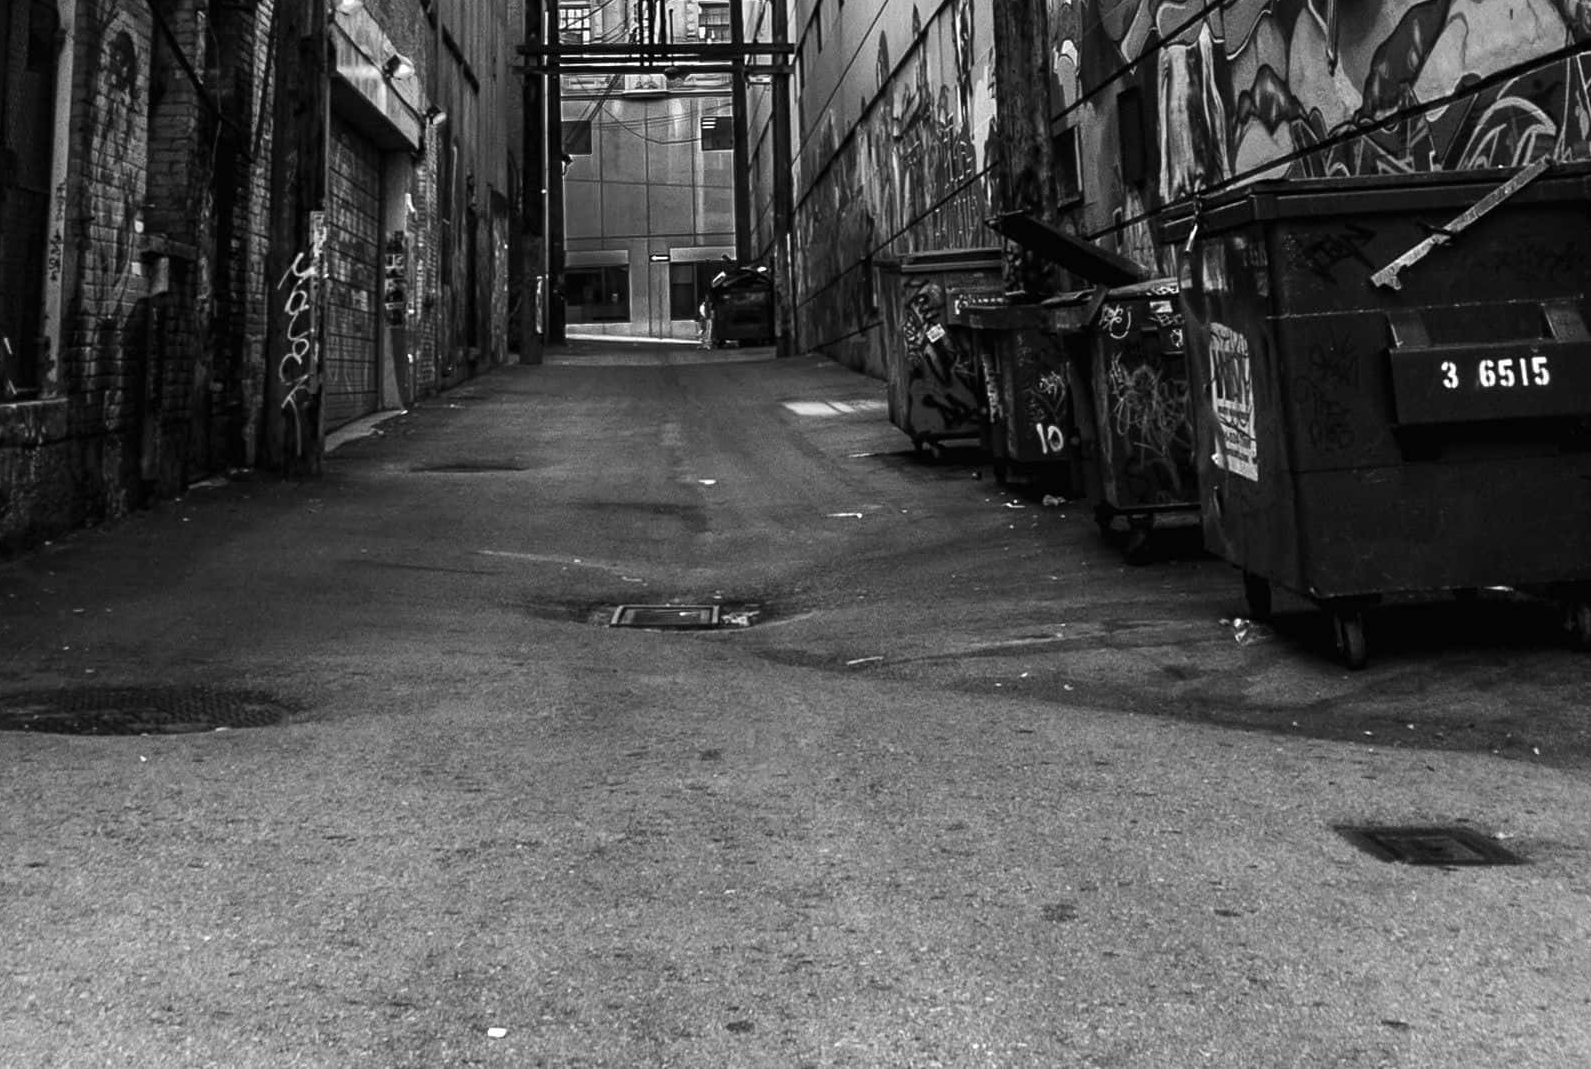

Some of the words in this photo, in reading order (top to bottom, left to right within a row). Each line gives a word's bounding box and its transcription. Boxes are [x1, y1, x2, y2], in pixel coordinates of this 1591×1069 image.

[1441, 361, 1459, 389] 3
[1478, 356, 1551, 387] 6515
[1037, 423, 1063, 454] 10
